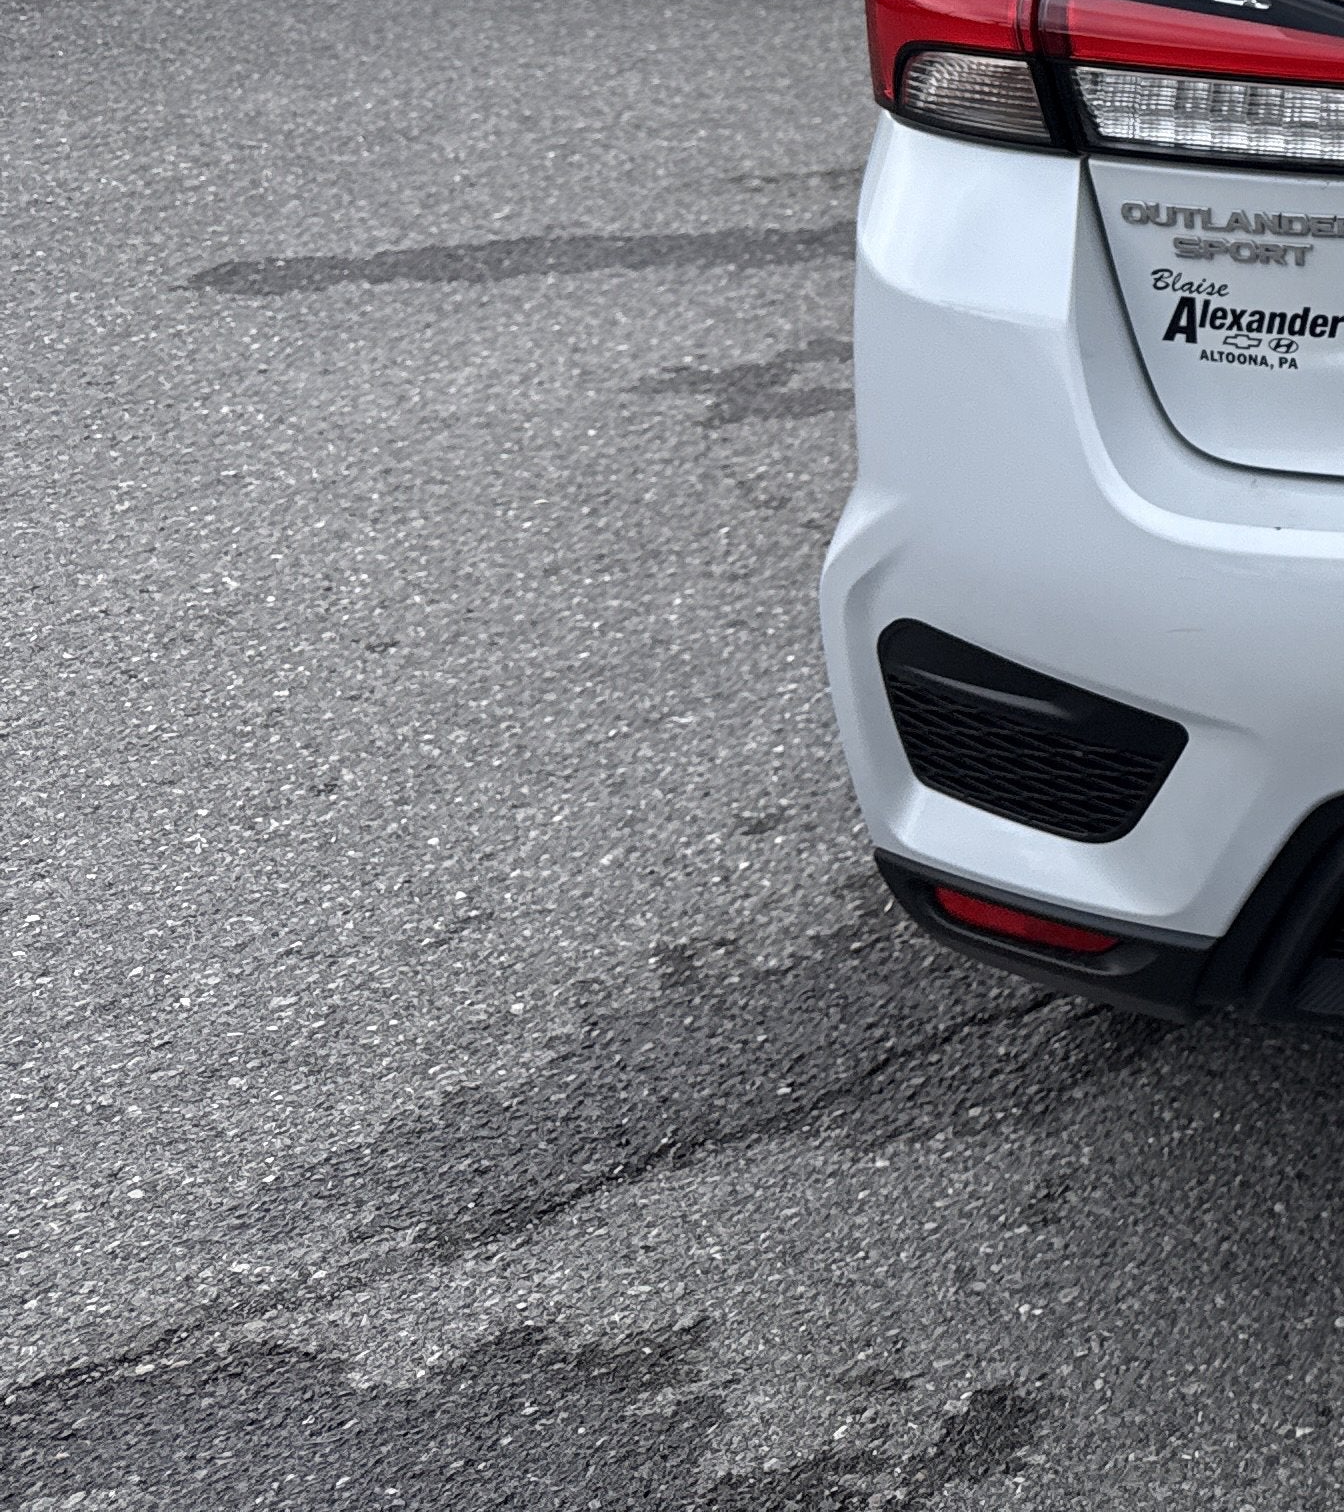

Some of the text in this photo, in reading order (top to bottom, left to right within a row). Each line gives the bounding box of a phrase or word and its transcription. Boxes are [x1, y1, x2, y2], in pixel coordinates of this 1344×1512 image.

[1173, 235, 1313, 267] SPORT
[1151, 268, 1230, 297] Blaise
[1200, 349, 1299, 370] ALTOONA, PA
